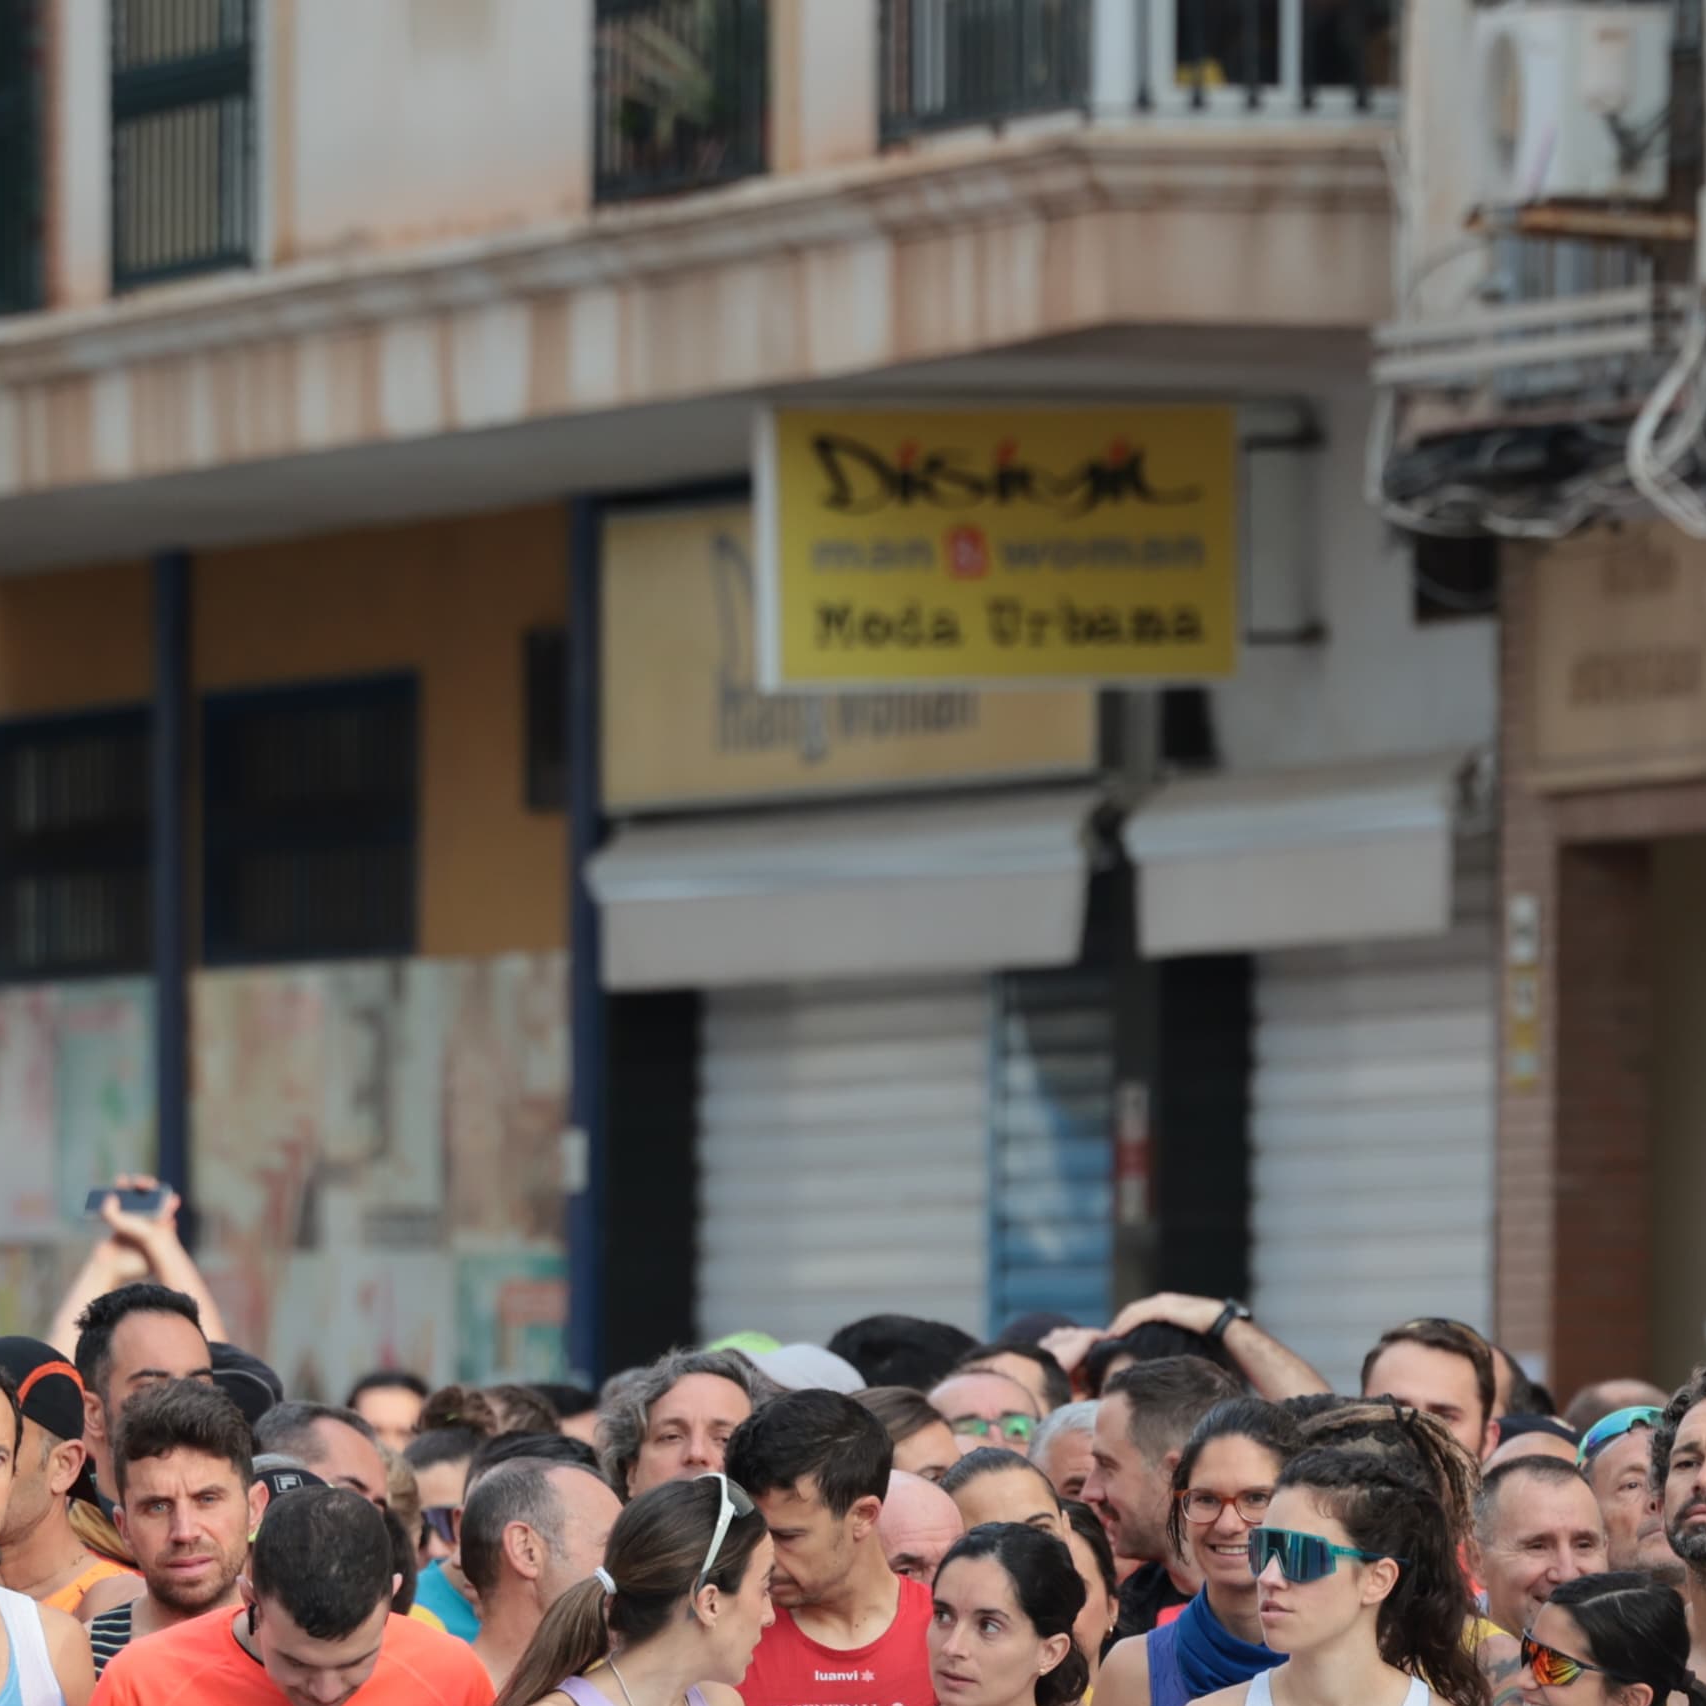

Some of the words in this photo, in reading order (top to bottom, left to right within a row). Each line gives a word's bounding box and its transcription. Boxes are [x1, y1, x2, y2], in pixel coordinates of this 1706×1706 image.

[811, 535, 934, 572] man
[1002, 535, 1204, 572] woman
[815, 602, 963, 648] Moda
[988, 599, 1204, 648] Urbana
[815, 1670, 859, 1682] luanvi
